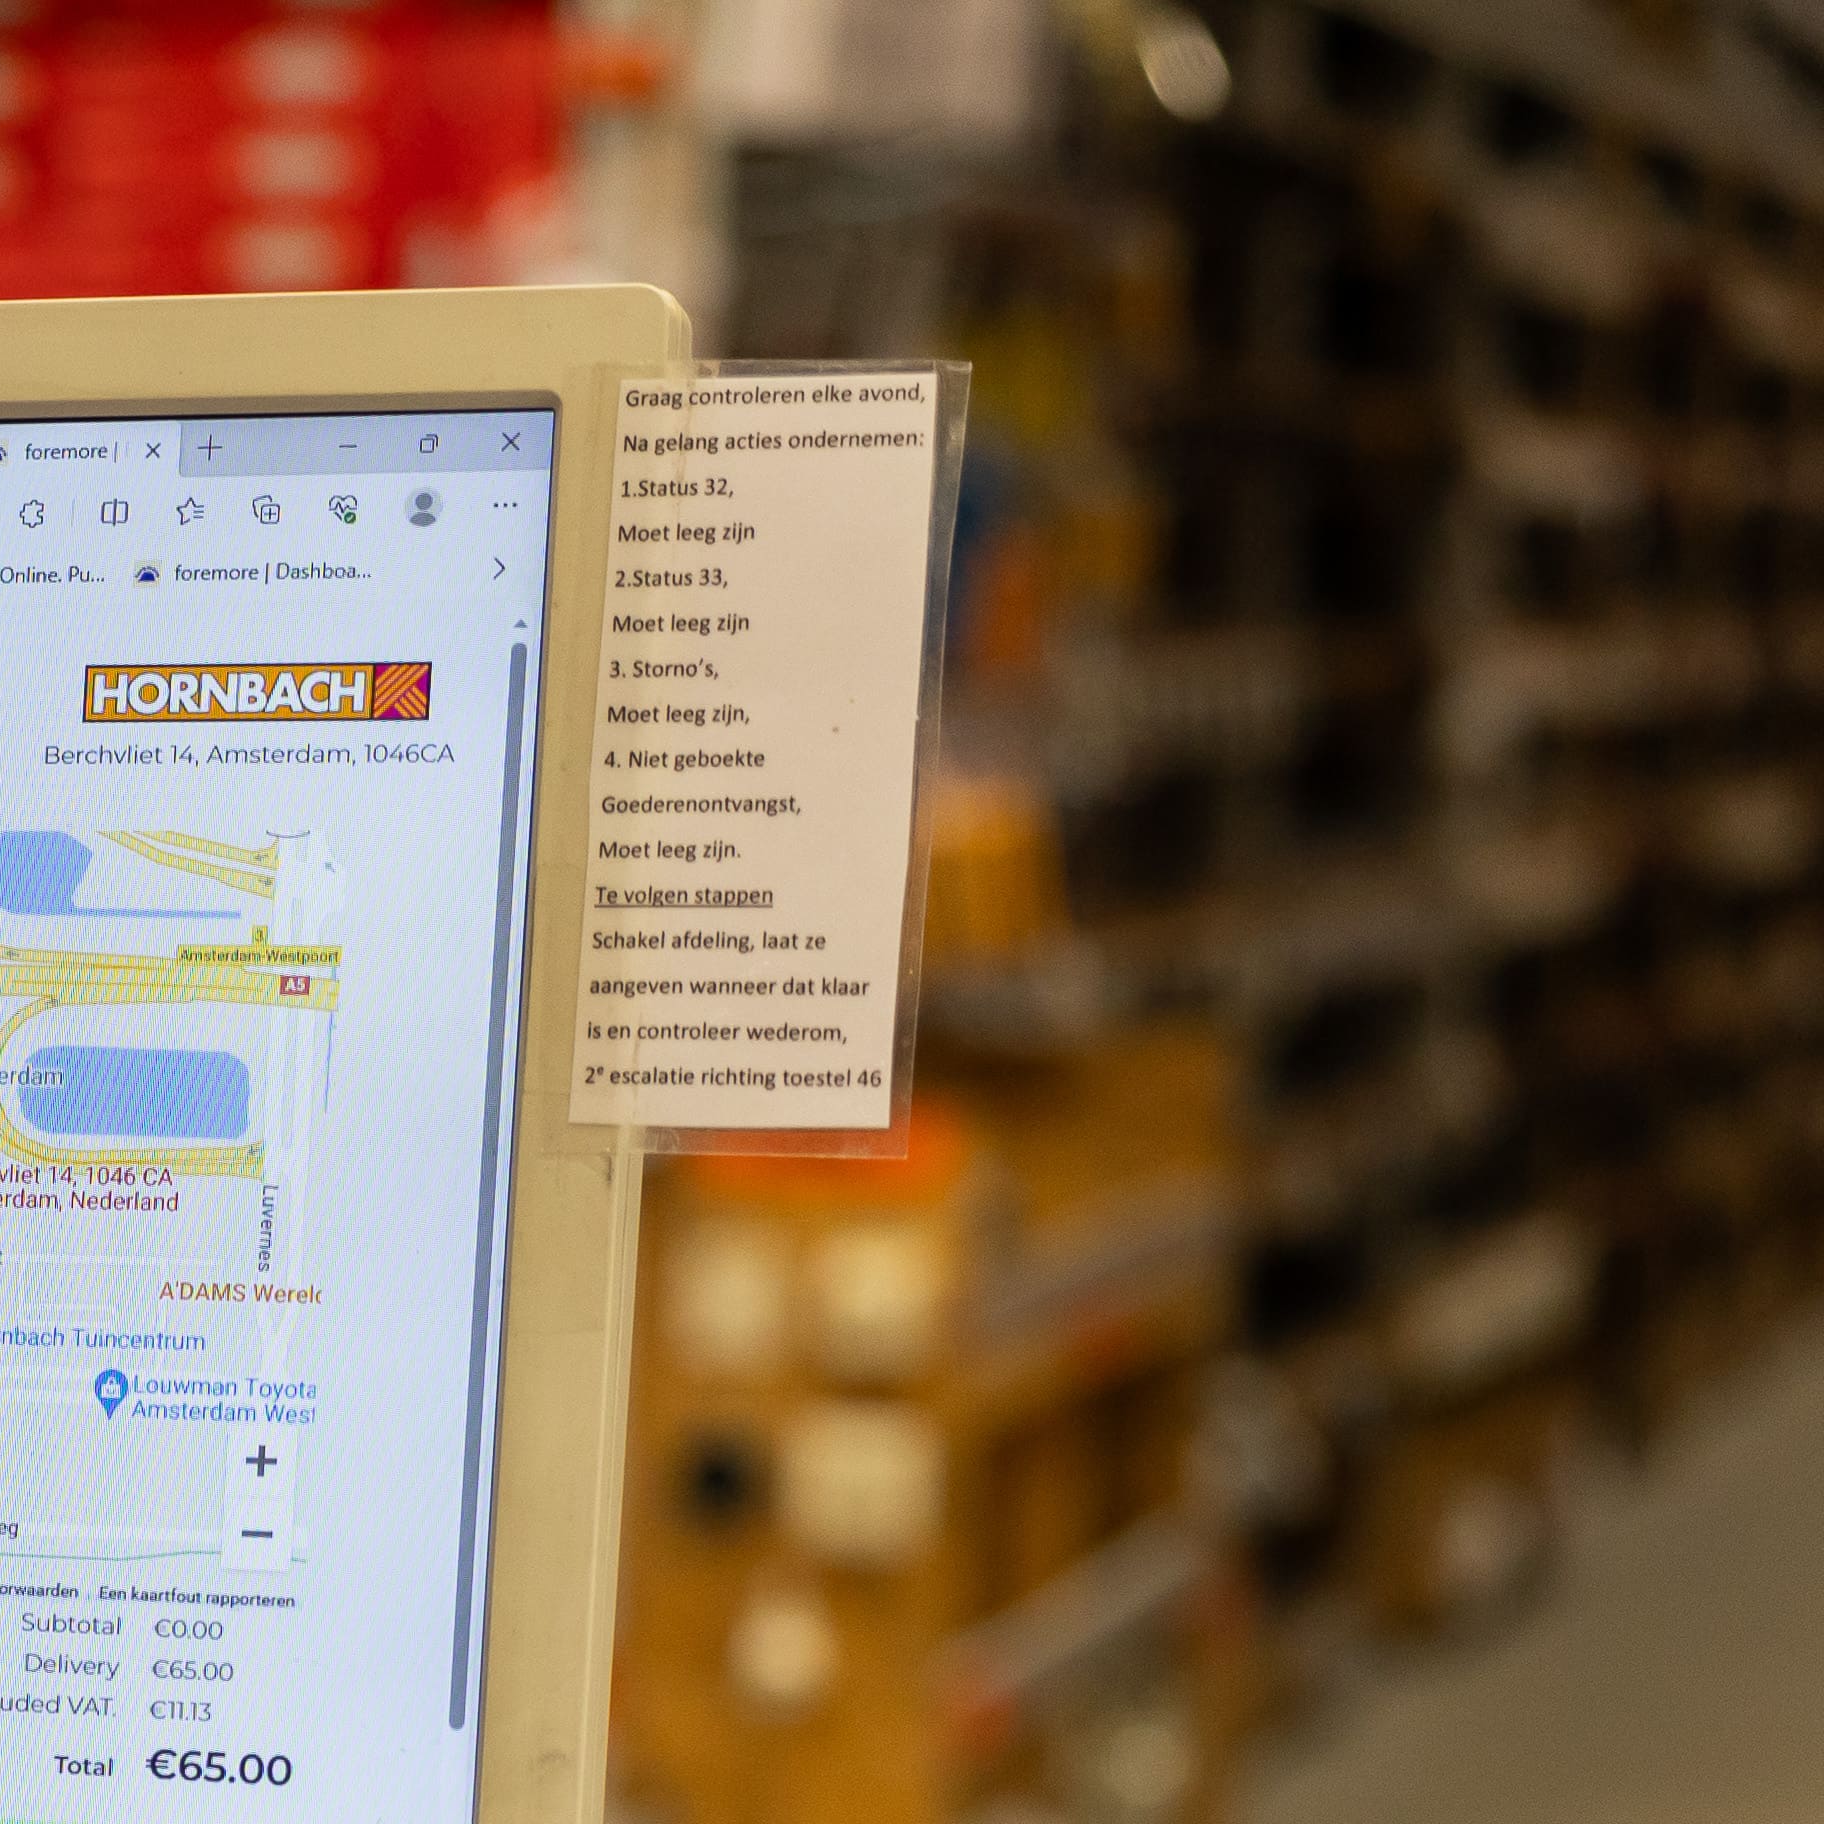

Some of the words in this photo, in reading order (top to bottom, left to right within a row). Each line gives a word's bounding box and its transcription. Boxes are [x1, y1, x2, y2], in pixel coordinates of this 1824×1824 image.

[625, 389, 683, 410] Graag
[688, 385, 805, 407] controleren
[811, 384, 853, 404] elke
[858, 382, 925, 404] avond,
[25, 443, 108, 461] foremore
[623, 435, 649, 453] Na
[653, 432, 719, 455] gelang
[724, 431, 782, 451] acties
[787, 429, 926, 451] ondernemen:
[621, 479, 698, 498] 1.Status
[704, 477, 734, 498] 32,
[617, 524, 670, 543] Moet
[676, 522, 716, 546] leeg
[722, 522, 755, 545] zijn
[0, 566, 62, 584] Online.
[174, 563, 260, 582] foremore
[614, 569, 693, 588] 2.Status
[699, 568, 728, 589] 33,
[612, 615, 664, 633] Moet
[670, 613, 711, 637] leeg
[716, 613, 750, 636] zijn
[609, 660, 626, 679] 3.
[90, 669, 368, 718] HORNBACH
[607, 705, 659, 724] Moet
[665, 704, 706, 727] leeg
[711, 704, 750, 727] zijn,
[44, 744, 163, 765] Berchvliet
[170, 744, 199, 768] 14,
[206, 743, 356, 766] Amsterdam,
[364, 743, 455, 764] 1046CA
[604, 750, 621, 768] 4.
[628, 750, 668, 769] Niet
[673, 749, 765, 773] geboekte
[601, 795, 801, 817] Goederenontvangst,
[598, 841, 650, 859] Moet
[656, 840, 697, 863] leeg
[702, 840, 741, 863] zijn.
[595, 886, 618, 903] Te
[621, 887, 688, 906] volgen
[694, 887, 774, 906] stappen
[592, 930, 666, 950] Schakel
[671, 930, 755, 954] afdeling,
[762, 931, 798, 950] laat
[805, 935, 827, 950] ze
[589, 979, 683, 999] aangeven
[689, 980, 777, 996] wanneer
[782, 976, 814, 996] dat
[821, 977, 870, 997] klaar
[587, 1022, 602, 1040] is
[606, 1025, 631, 1040] en
[636, 1022, 741, 1041] controleer
[746, 1023, 847, 1045] wederom,
[609, 1066, 695, 1086] escalatie
[701, 1067, 776, 1091] richting
[782, 1068, 852, 1088] toestel
[856, 1069, 882, 1088] 46
[21, 1612, 122, 1636] Subtotal
[153, 1618, 224, 1641] €0.00
[24, 1652, 120, 1681] Delivery
[151, 1659, 234, 1682] €65.00
[66, 1697, 117, 1717] VAT.
[149, 1700, 212, 1722] €11.13
[53, 1755, 114, 1777] Total
[146, 1748, 292, 1786] €65.00
